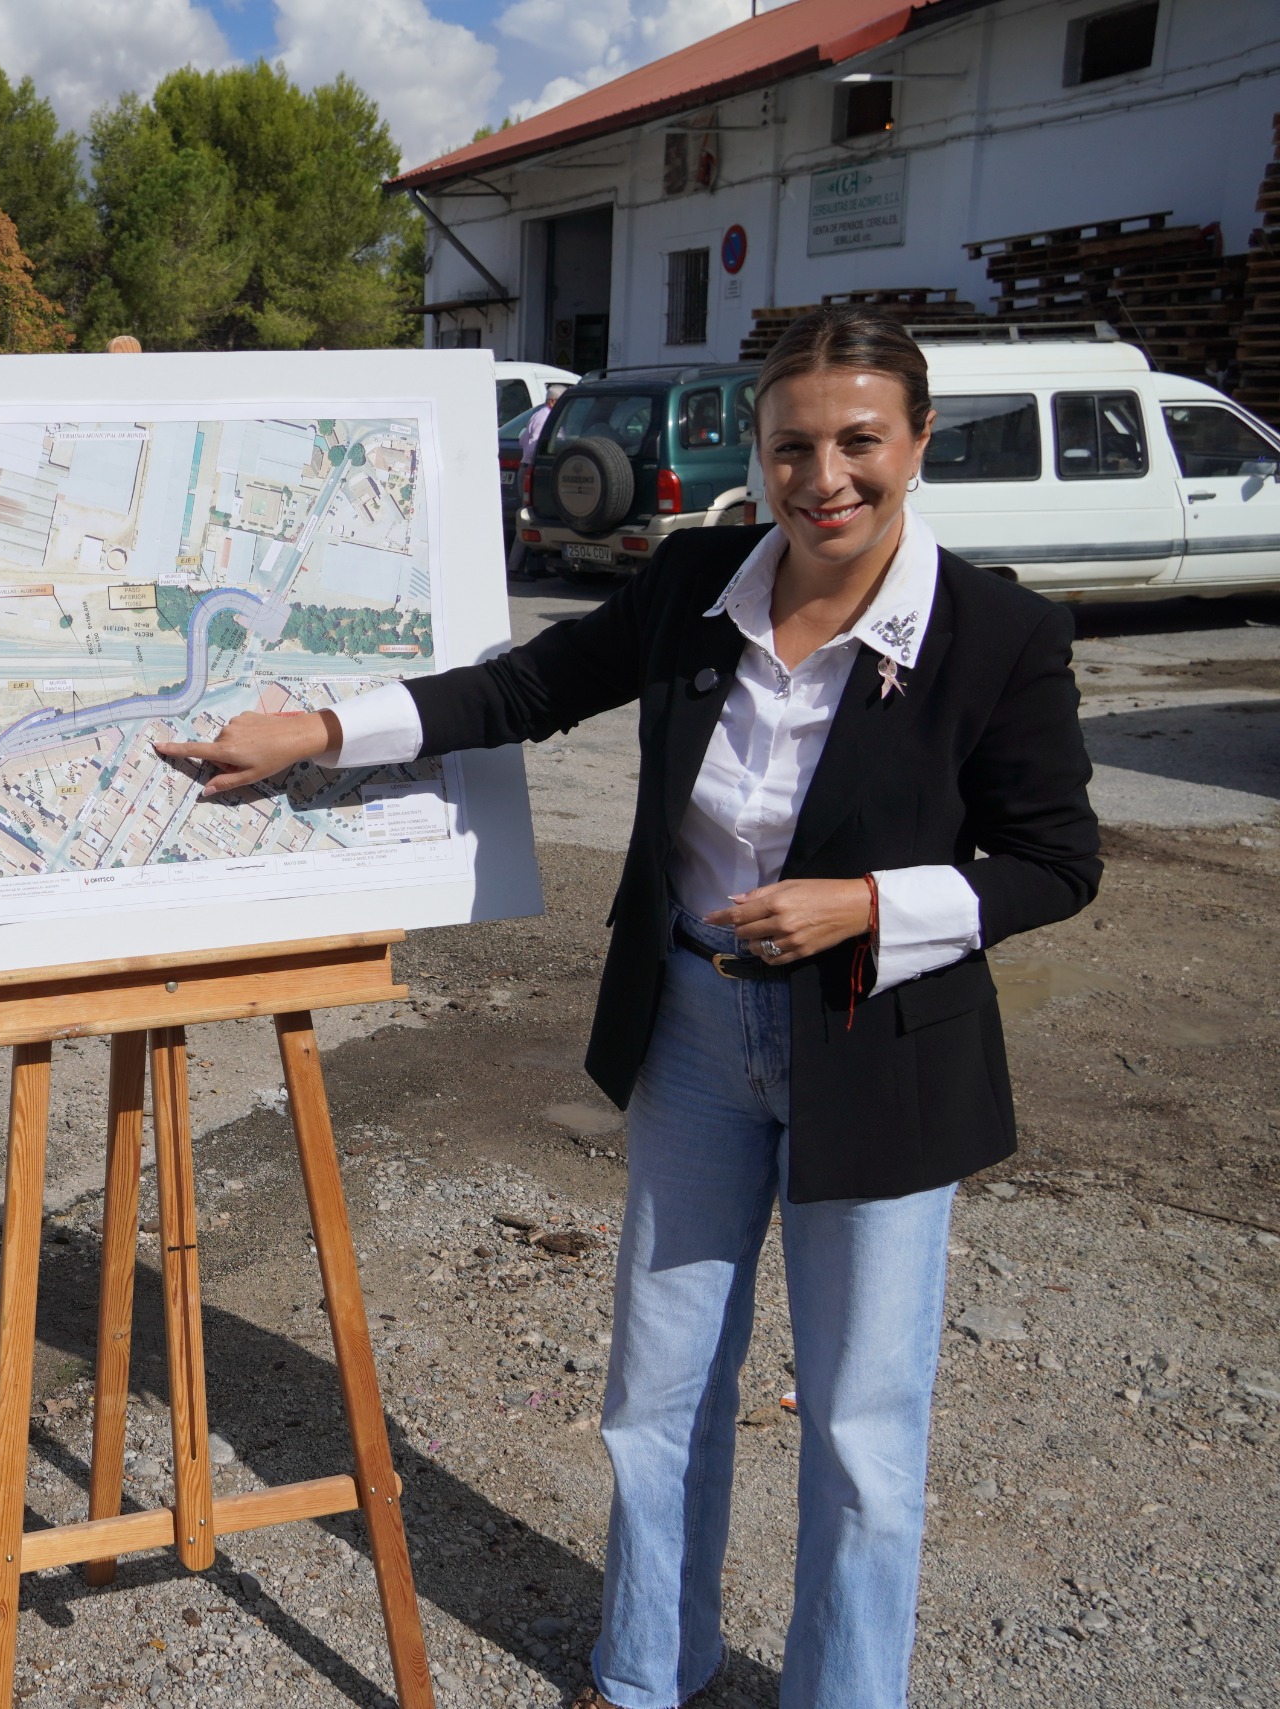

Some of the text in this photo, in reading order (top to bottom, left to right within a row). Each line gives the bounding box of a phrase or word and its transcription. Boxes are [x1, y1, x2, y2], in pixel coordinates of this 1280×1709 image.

[561, 475, 594, 484] SUZUKI
[568, 545, 610, 559] 2504 CDV
